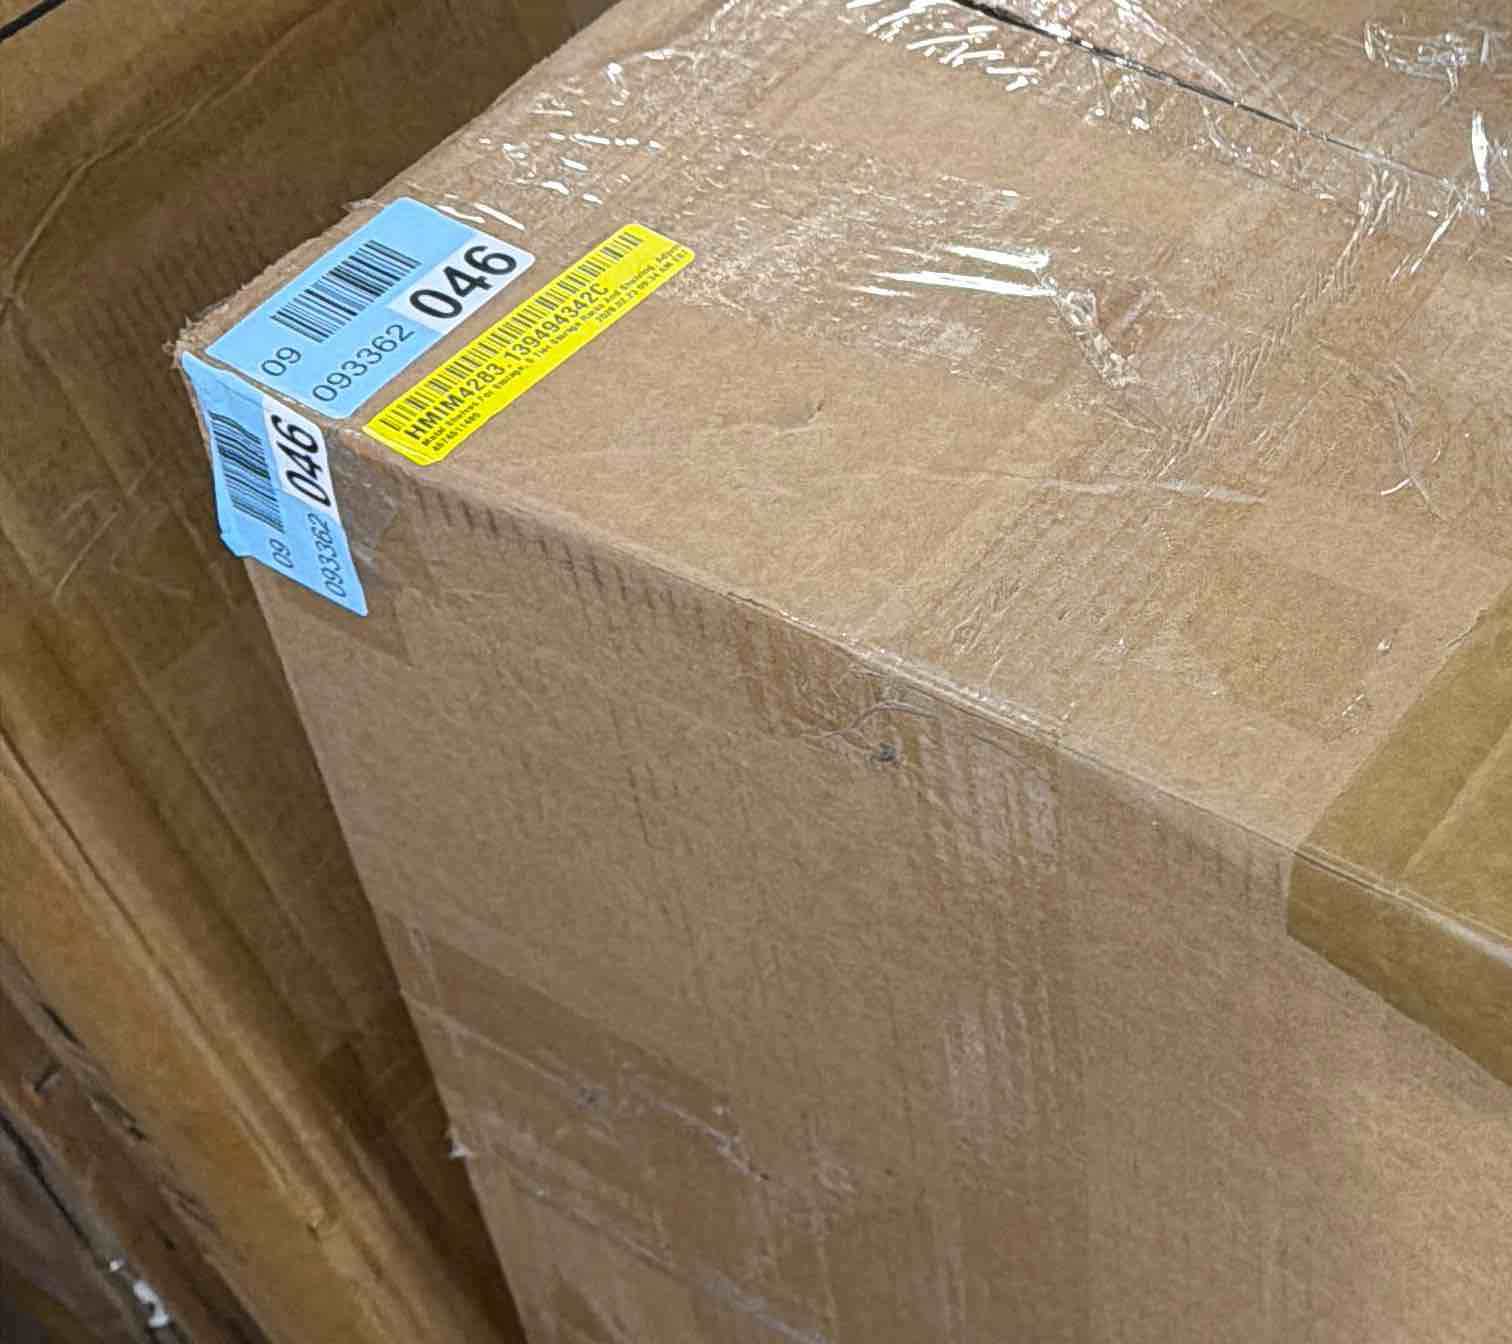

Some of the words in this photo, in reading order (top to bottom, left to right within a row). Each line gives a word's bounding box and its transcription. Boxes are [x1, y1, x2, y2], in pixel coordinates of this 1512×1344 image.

[409, 245, 518, 320] 046
[260, 345, 302, 378] 09
[311, 323, 416, 403] 093362
[271, 414, 331, 507] 046
[268, 538, 295, 569] 09
[307, 512, 347, 597] 093362
